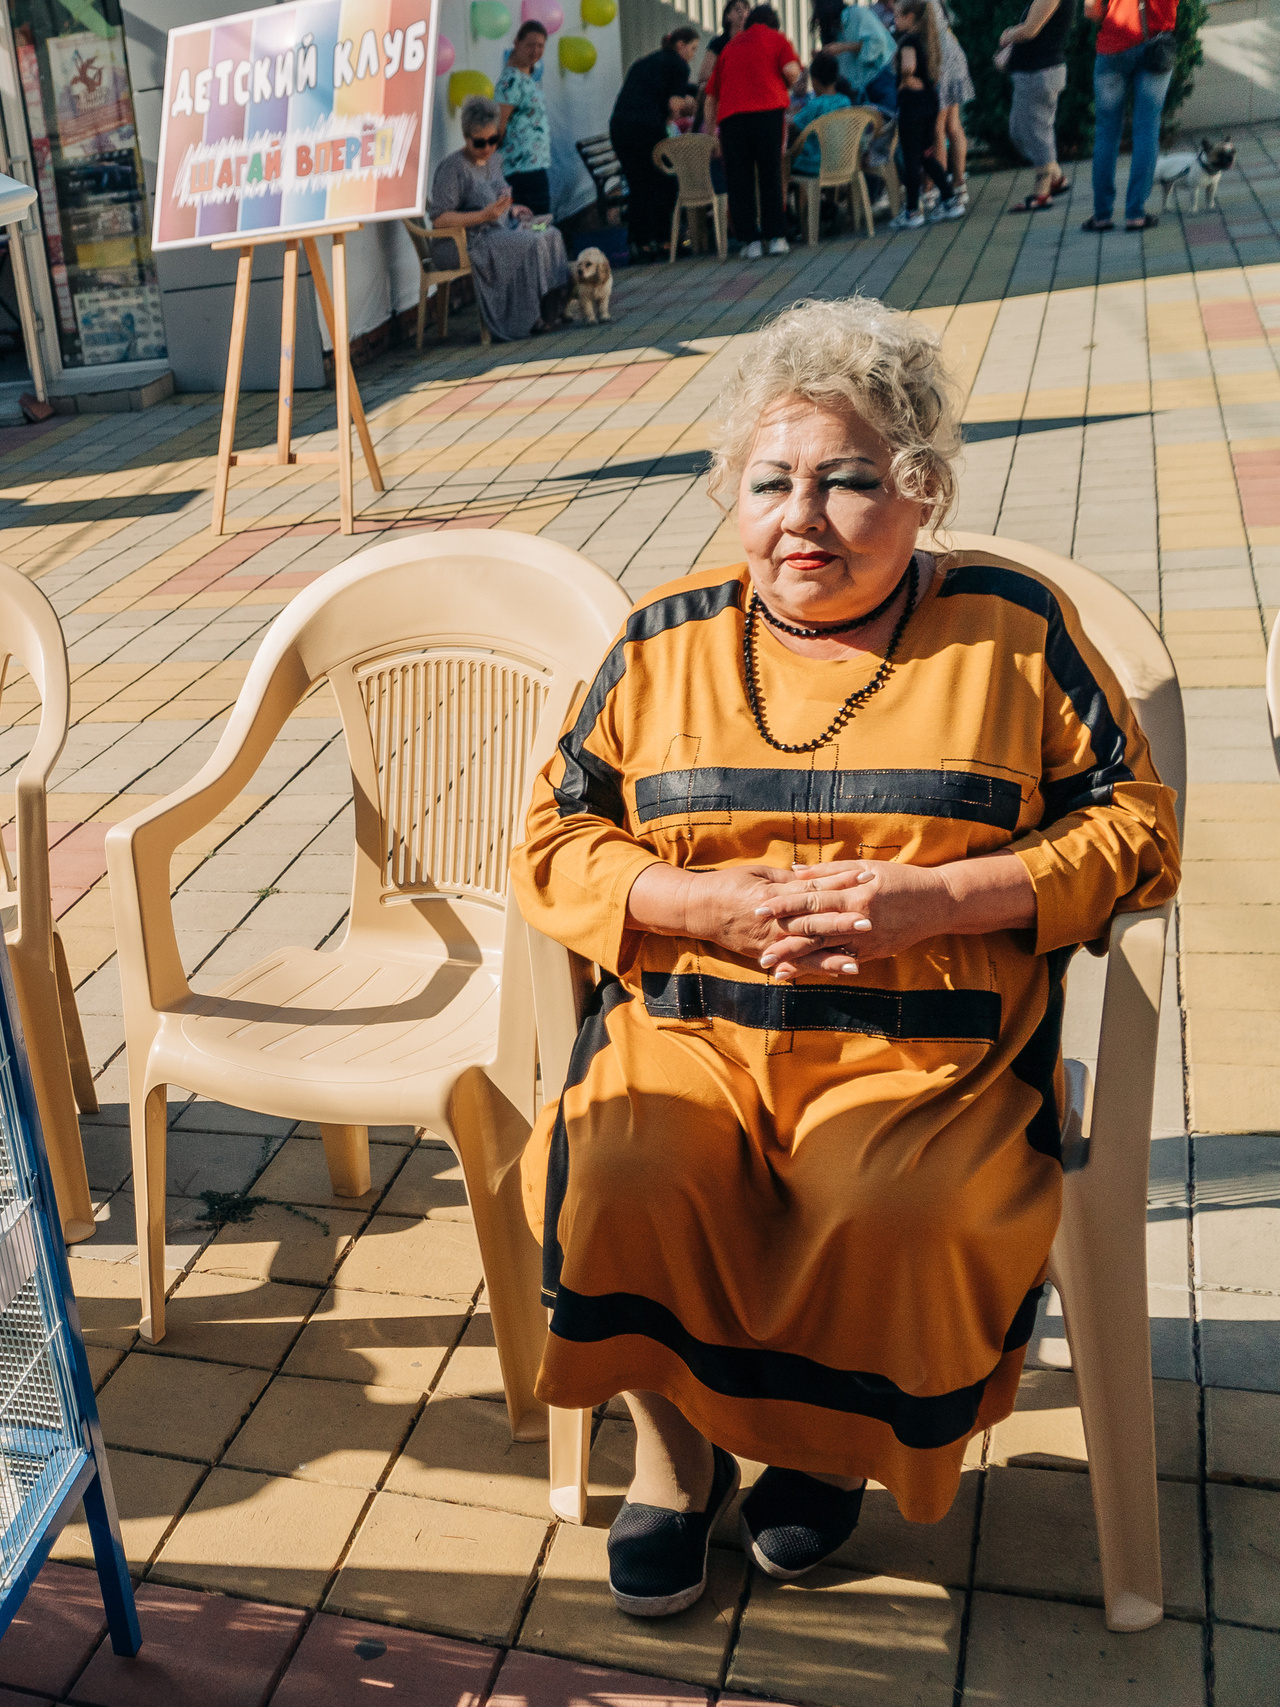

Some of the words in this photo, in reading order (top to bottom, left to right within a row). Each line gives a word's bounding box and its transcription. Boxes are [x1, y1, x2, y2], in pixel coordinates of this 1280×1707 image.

[171, 32, 317, 117] ДЕТСКИЙ
[333, 20, 427, 89] КЛУБ
[190, 140, 282, 194] ШАГАЙ
[296, 122, 394, 178] ВПЕРЁД
